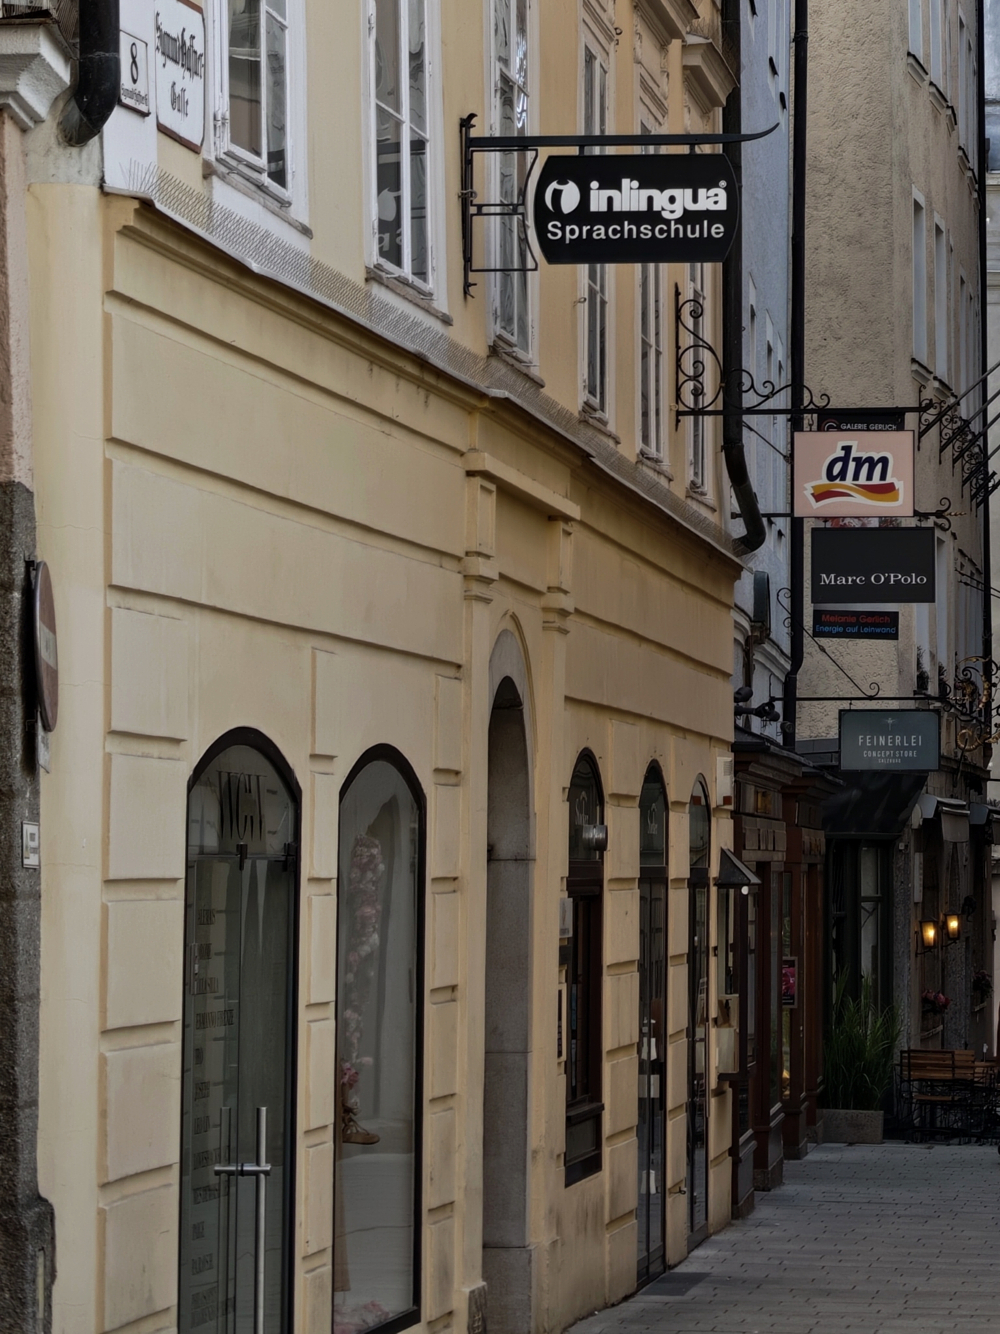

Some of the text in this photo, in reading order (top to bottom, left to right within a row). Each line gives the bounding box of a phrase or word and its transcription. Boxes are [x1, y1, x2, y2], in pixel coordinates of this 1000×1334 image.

[131, 43, 139, 85] 8
[547, 221, 725, 243] Sprachschule
[841, 423, 868, 431] GALERIE
[826, 445, 889, 482] dm
[820, 573, 927, 585] Marc O'Polo
[822, 614, 891, 624] Melanie Gerlich
[816, 625, 844, 634] Energie
[860, 626, 896, 634] Leinwand
[859, 735, 922, 746] FEINERLEI
